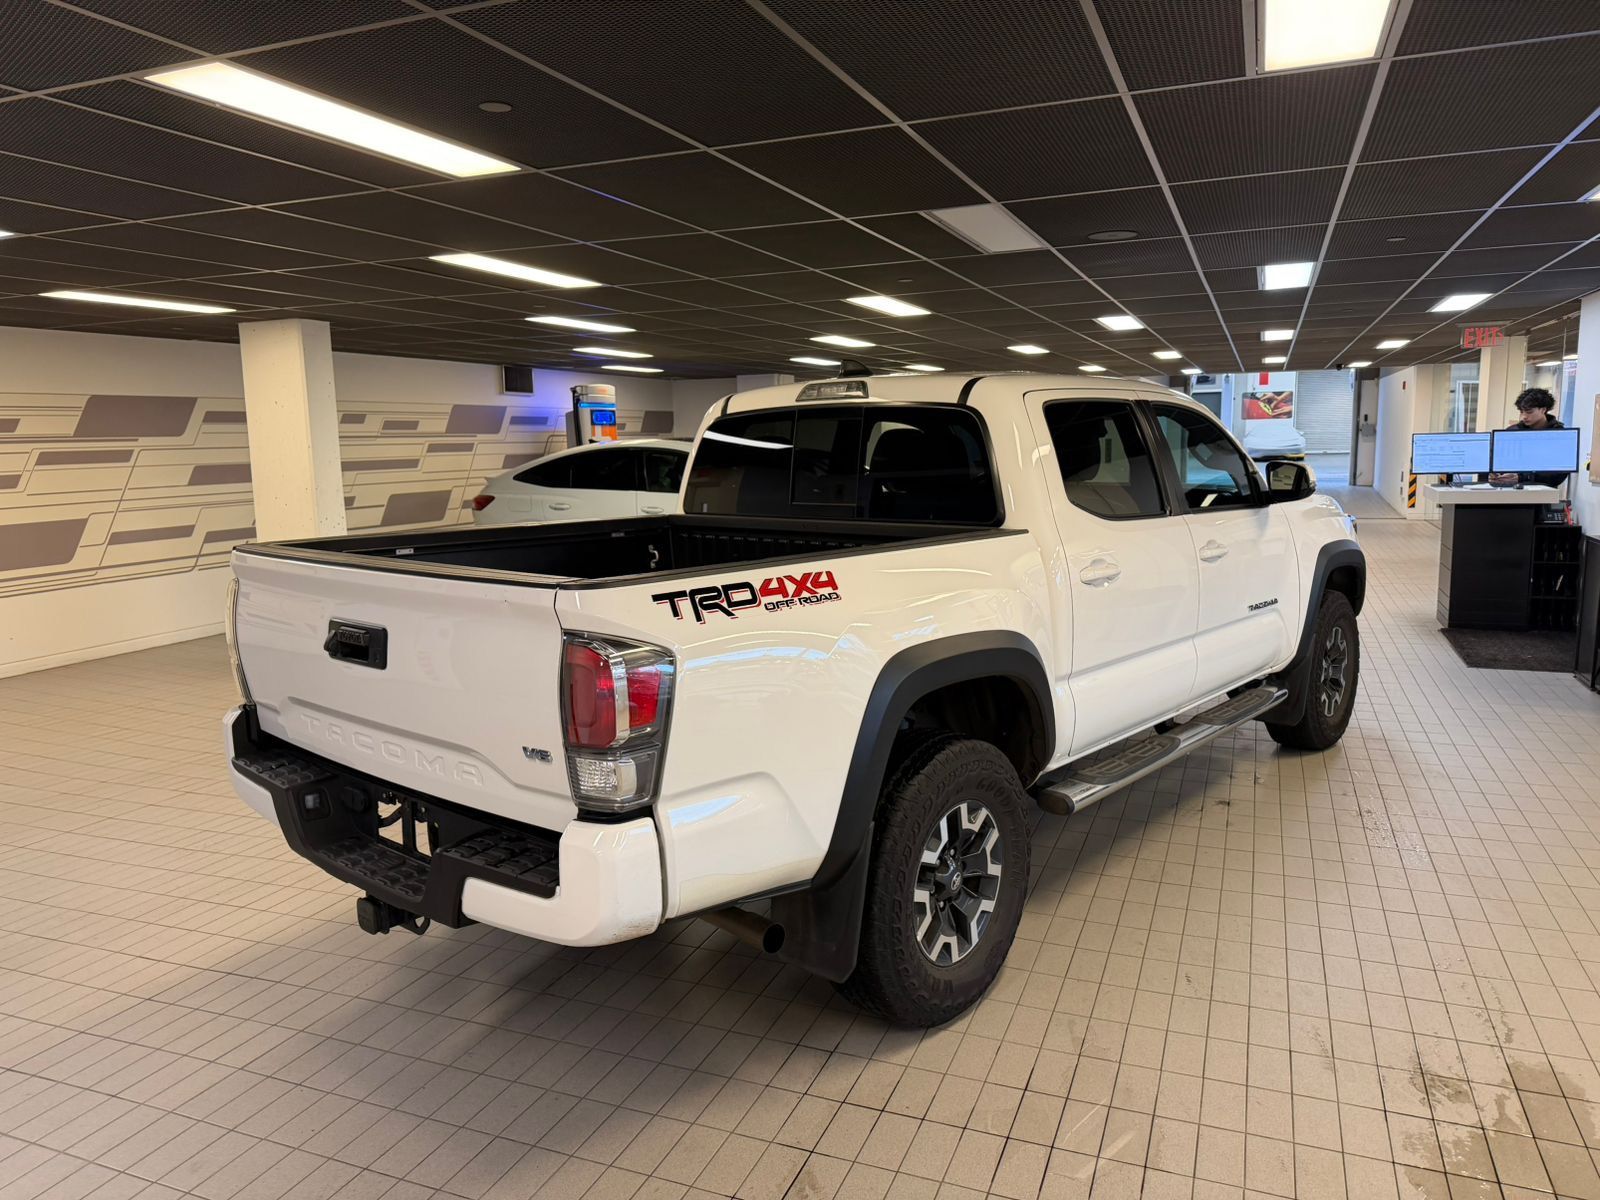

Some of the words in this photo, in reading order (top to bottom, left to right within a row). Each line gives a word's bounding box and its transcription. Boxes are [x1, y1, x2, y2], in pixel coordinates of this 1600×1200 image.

[1464, 327, 1499, 348] EXIT
[651, 581, 761, 624] TRD
[764, 598, 796, 612] OFF
[799, 592, 841, 606] ROAD
[300, 714, 485, 787] TACOMA
[522, 746, 553, 763] V6
